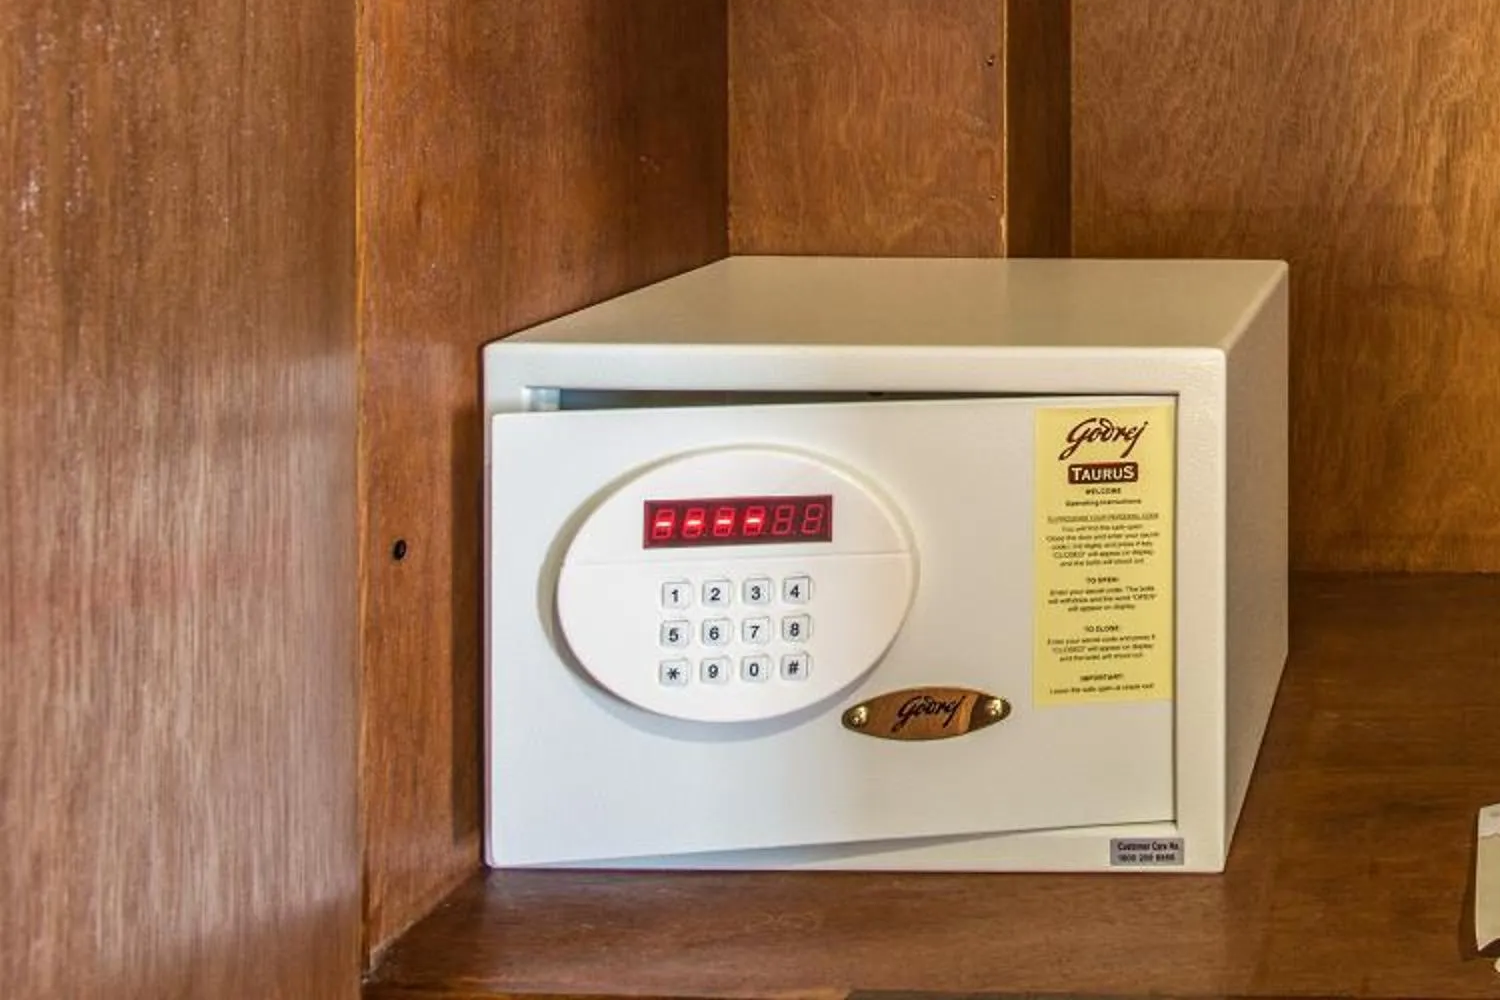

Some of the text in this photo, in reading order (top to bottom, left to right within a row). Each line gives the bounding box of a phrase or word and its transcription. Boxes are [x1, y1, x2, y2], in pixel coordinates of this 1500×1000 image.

[1058, 417, 1149, 461] Godrej
[1072, 466, 1135, 481] TAURUS
[671, 585, 800, 602] 1 2 3 4
[669, 623, 800, 642] 5 6 7 8
[708, 665, 719, 679] 9
[749, 663, 760, 677] 0
[891, 695, 966, 733] Godrej
